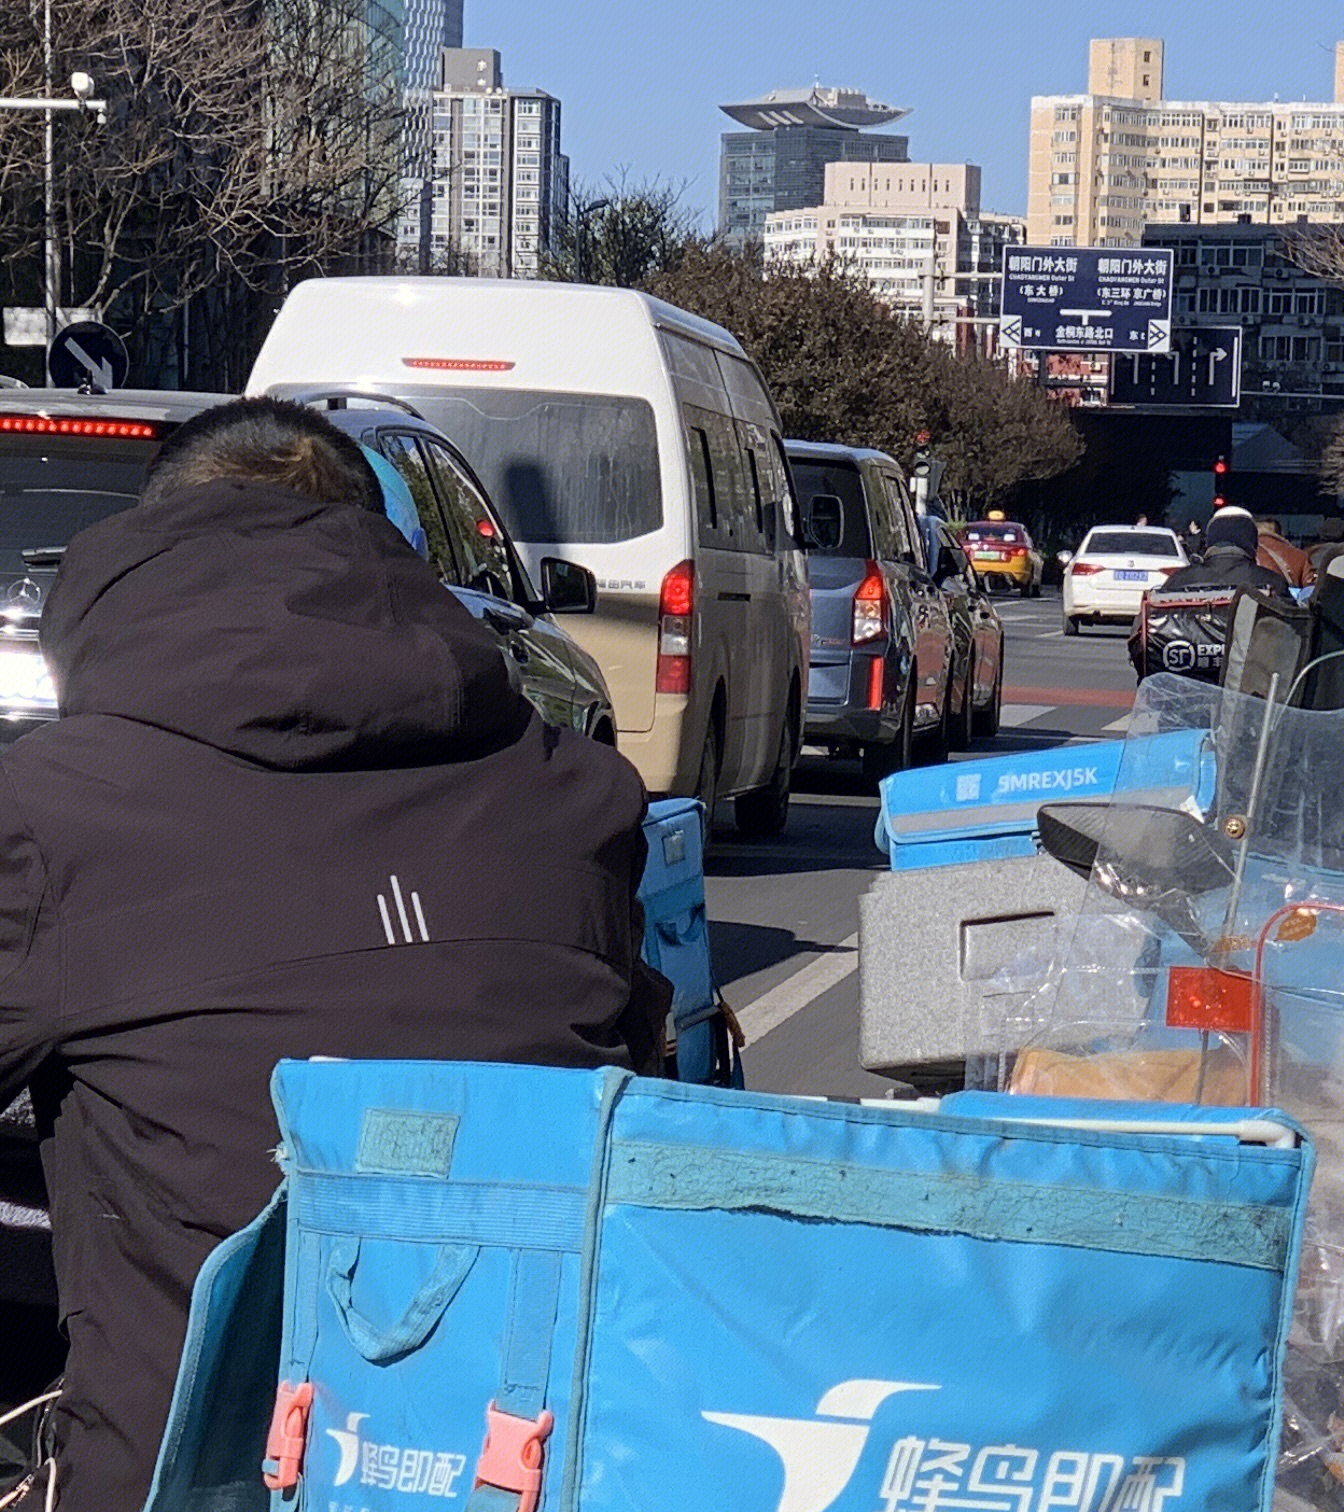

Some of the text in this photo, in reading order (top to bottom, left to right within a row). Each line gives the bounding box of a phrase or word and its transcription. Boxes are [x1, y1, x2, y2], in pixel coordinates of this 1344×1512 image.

[1008, 256, 1078, 272] 朝阳门外大街
[1097, 258, 1168, 275] 朝阳门外大街
[1197, 644, 1225, 655] EXP
[360, 1440, 466, 1498] 蜂鸟即配
